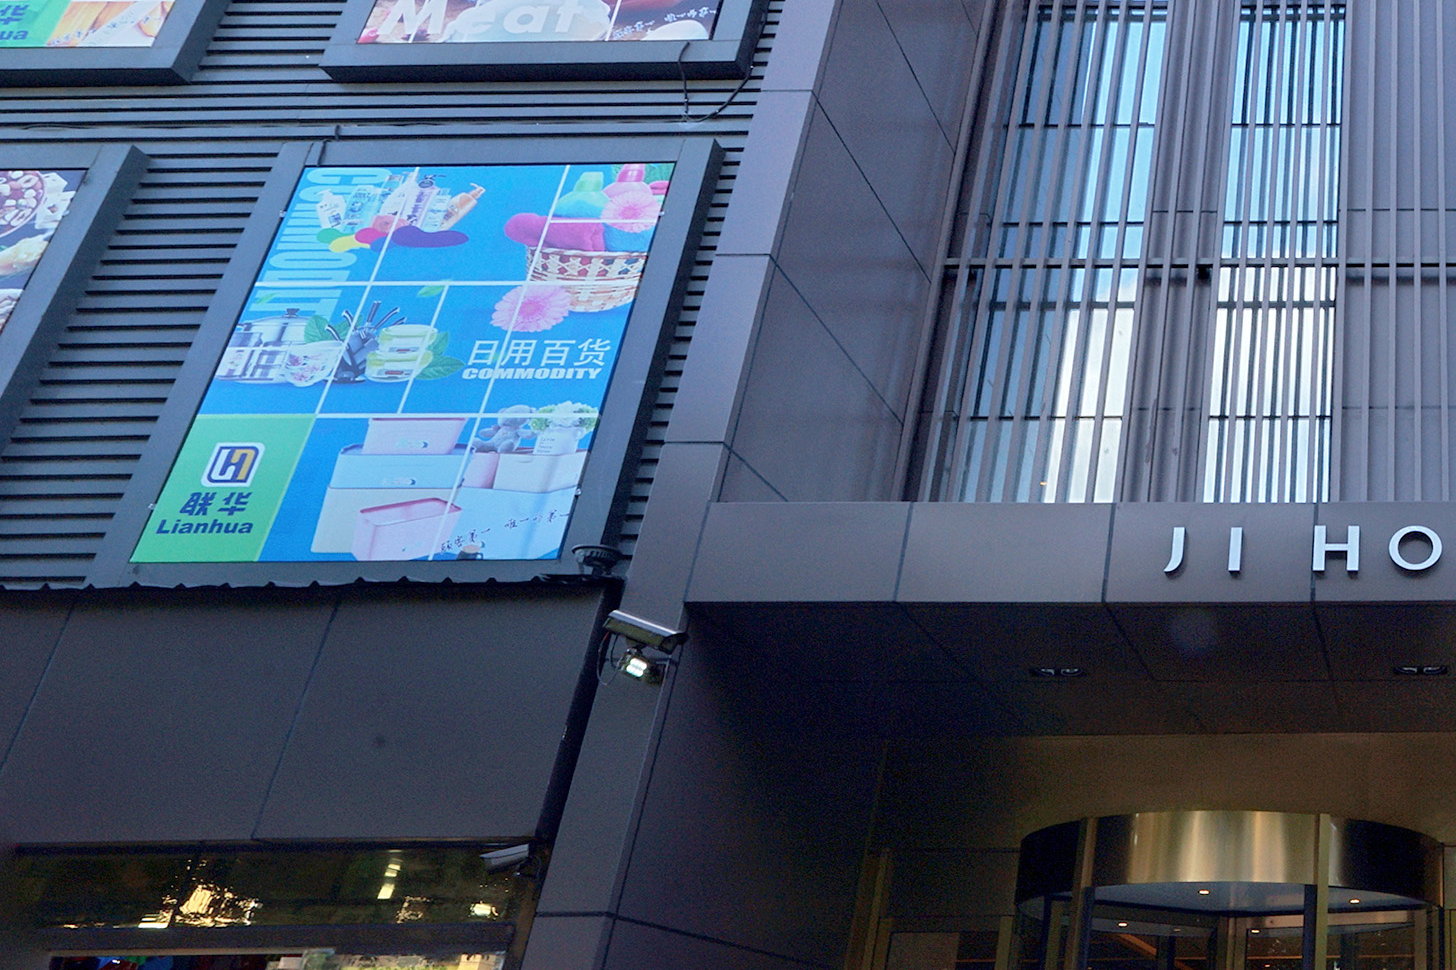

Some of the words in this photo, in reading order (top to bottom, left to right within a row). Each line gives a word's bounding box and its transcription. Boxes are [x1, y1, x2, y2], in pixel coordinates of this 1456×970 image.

[467, 338, 611, 367] 日用百货
[462, 367, 602, 380] COMMODITY
[179, 492, 252, 516] 联华
[156, 519, 254, 534] Lianhua
[1163, 526, 1243, 575] JI
